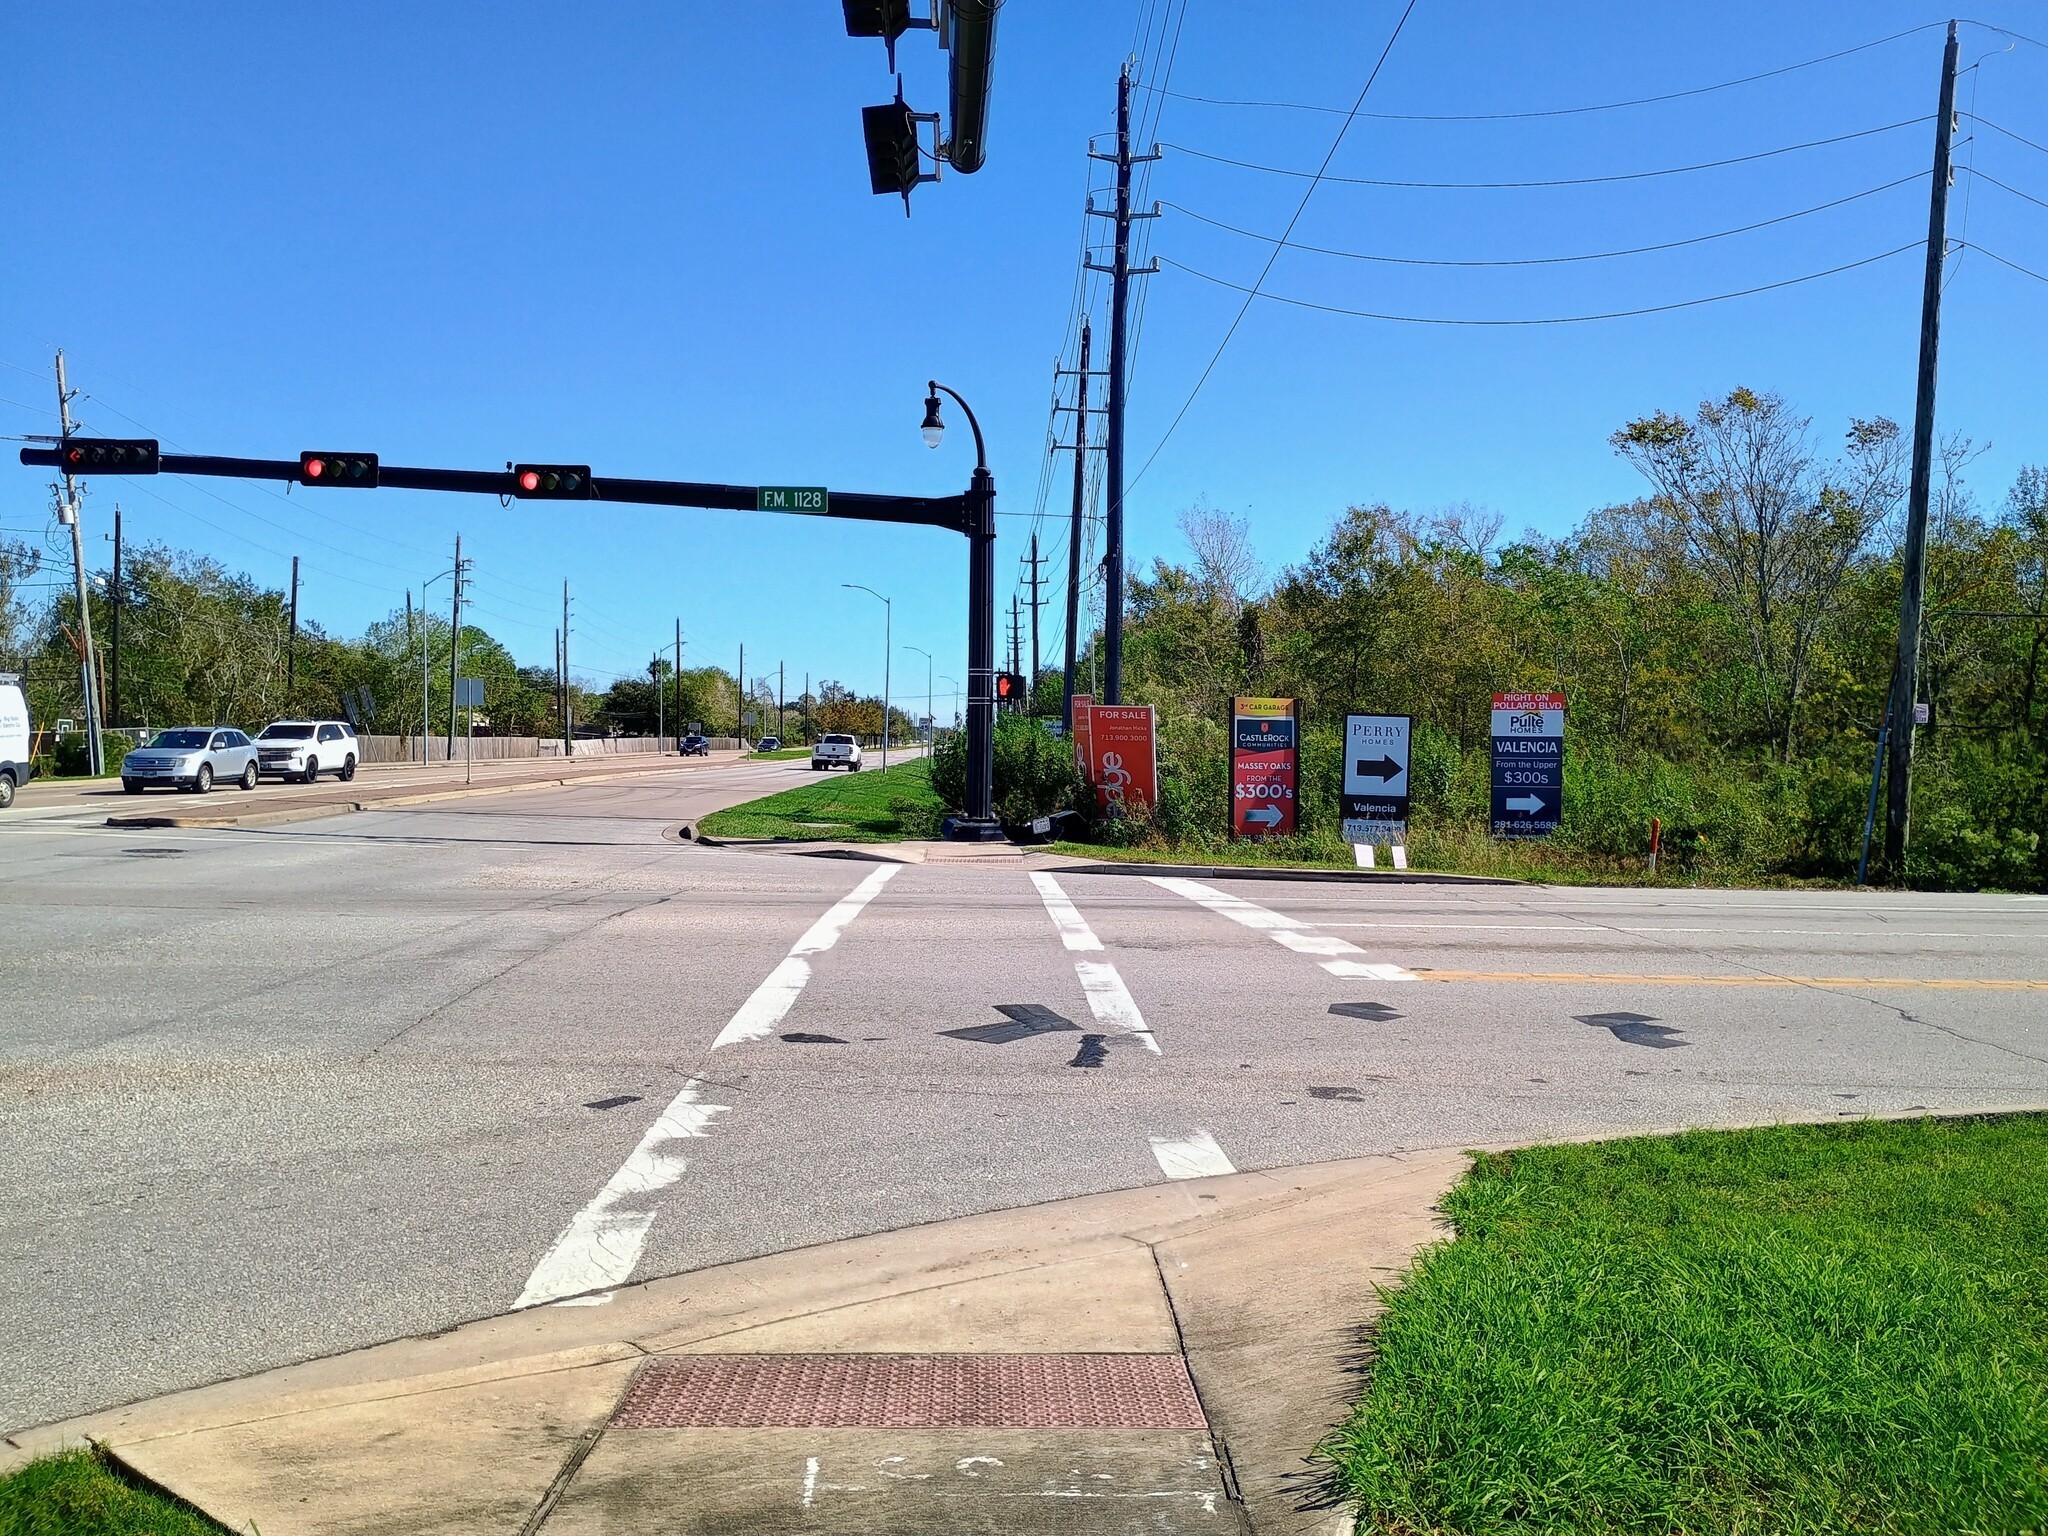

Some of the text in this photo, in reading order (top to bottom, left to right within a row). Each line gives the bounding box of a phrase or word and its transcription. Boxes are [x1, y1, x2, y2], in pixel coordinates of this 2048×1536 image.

[794, 491, 822, 508] 1128
[1503, 693, 1549, 702] RIGHT ON
[1249, 703, 1263, 711] CAR
[1263, 703, 1289, 711] GARAGE
[1493, 701, 1562, 710] POLLARD BLVD
[1099, 711, 1147, 720] FOR SALE
[1510, 714, 1544, 728] Pulte
[1352, 723, 1404, 737] PERRY
[1101, 734, 1148, 742] 713.900.3000
[1361, 738, 1395, 746] HOMES
[1496, 741, 1558, 753] VALENCIA
[1237, 762, 1292, 770] MASSEY OAKS
[1495, 760, 1558, 769] From the Upper
[1504, 770, 1549, 784] $300s
[1235, 782, 1293, 800] $300's
[1353, 802, 1397, 813] Valencia
[1494, 820, 1558, 829] 281-626-5588
